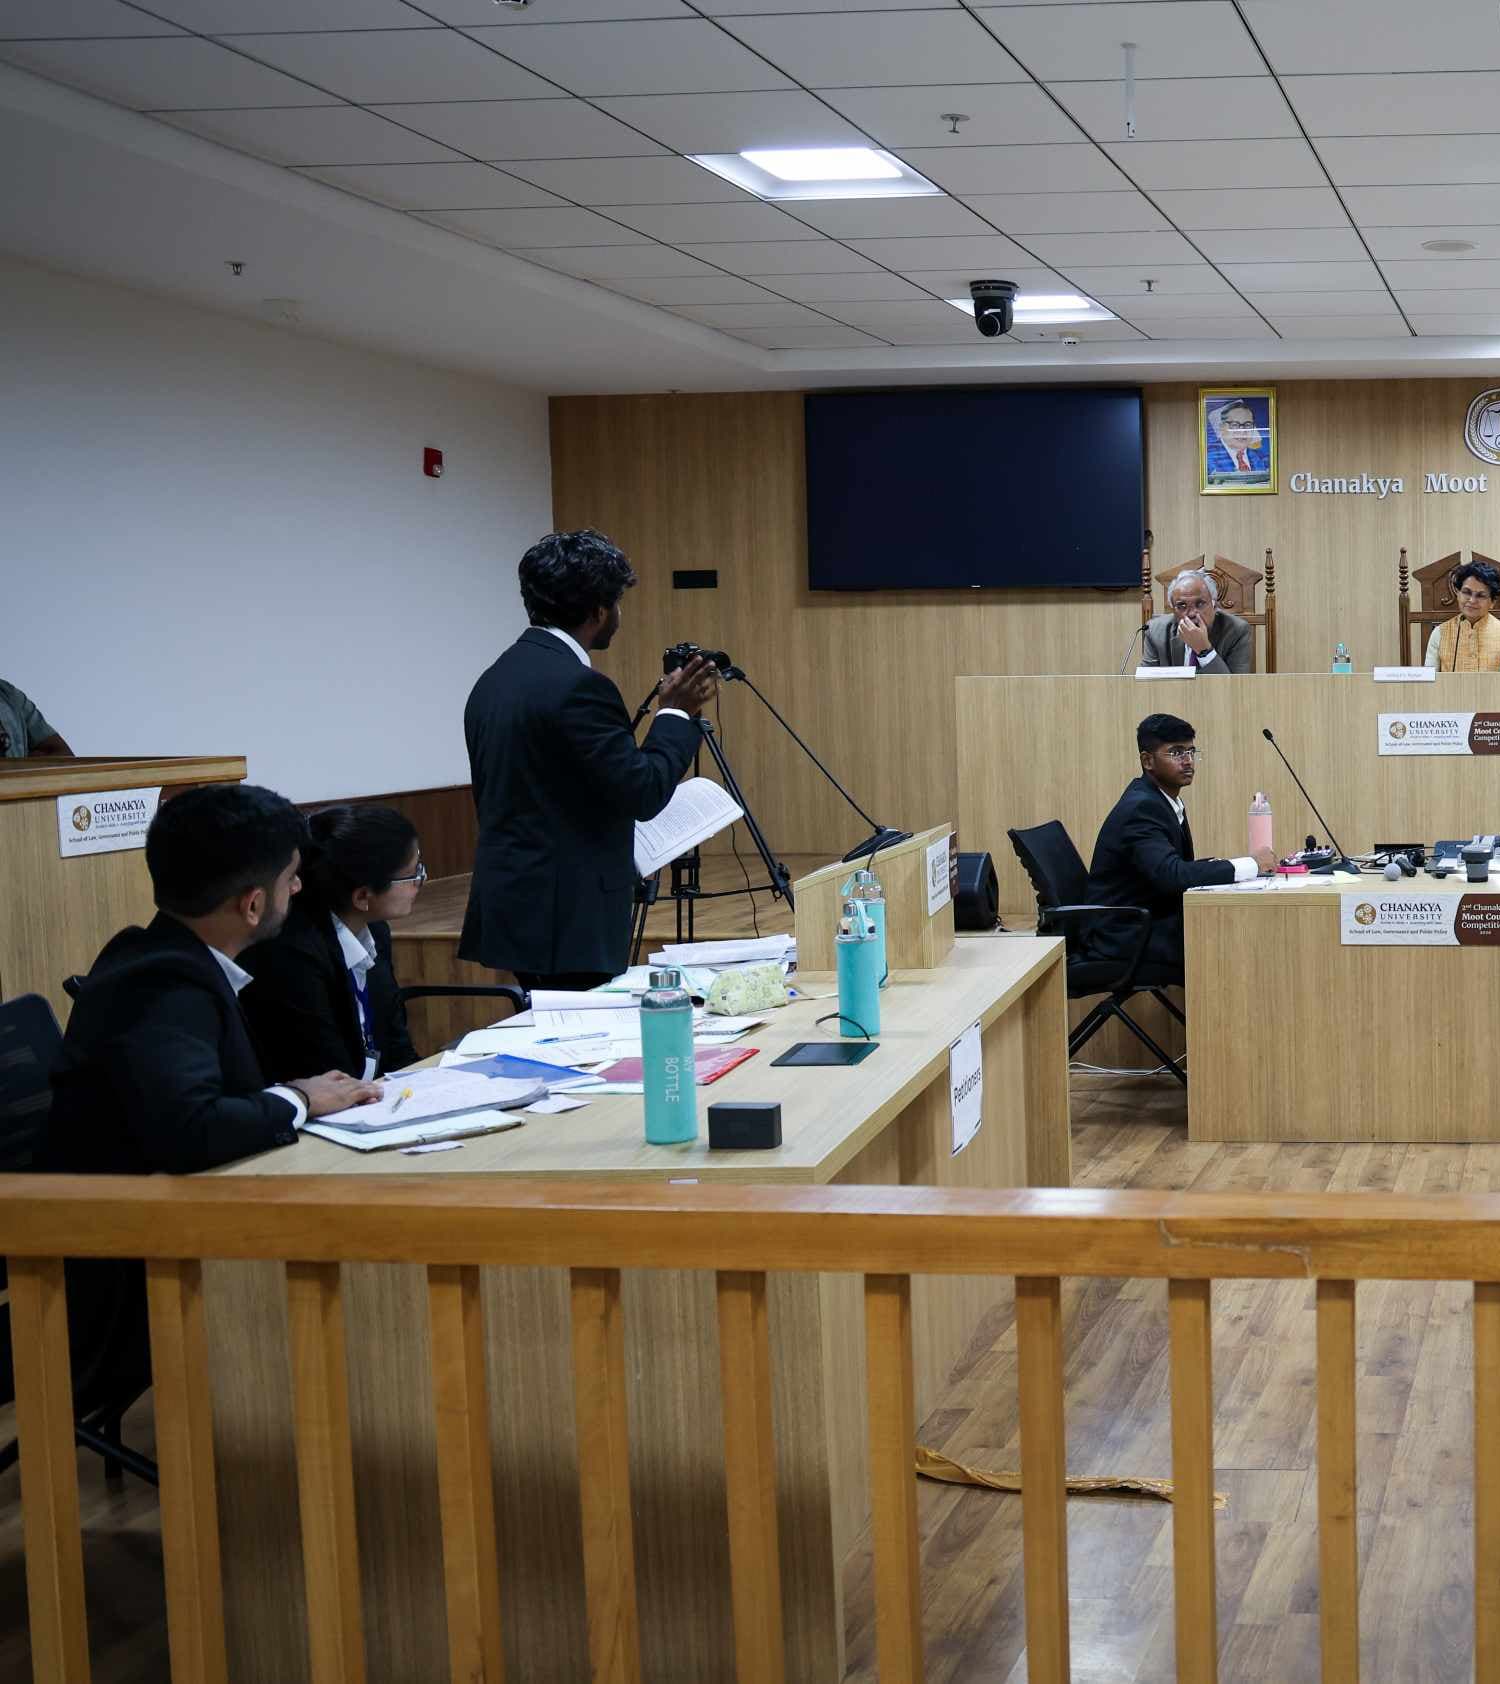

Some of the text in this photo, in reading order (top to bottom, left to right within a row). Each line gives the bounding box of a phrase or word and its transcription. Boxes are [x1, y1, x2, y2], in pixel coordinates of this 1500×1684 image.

[1289, 472, 1404, 500] Chanakya
[1424, 472, 1488, 494] Moot
[1409, 720, 1459, 729] CHANAKYA
[94, 799, 146, 814] CHANAKYA
[94, 811, 146, 824] UNIVERSITY
[1380, 902, 1442, 912] CHANAKYA
[1462, 913, 1484, 921] Moot
[664, 1056, 680, 1103] BOTTLE
[953, 1066, 981, 1108] Petitioners
